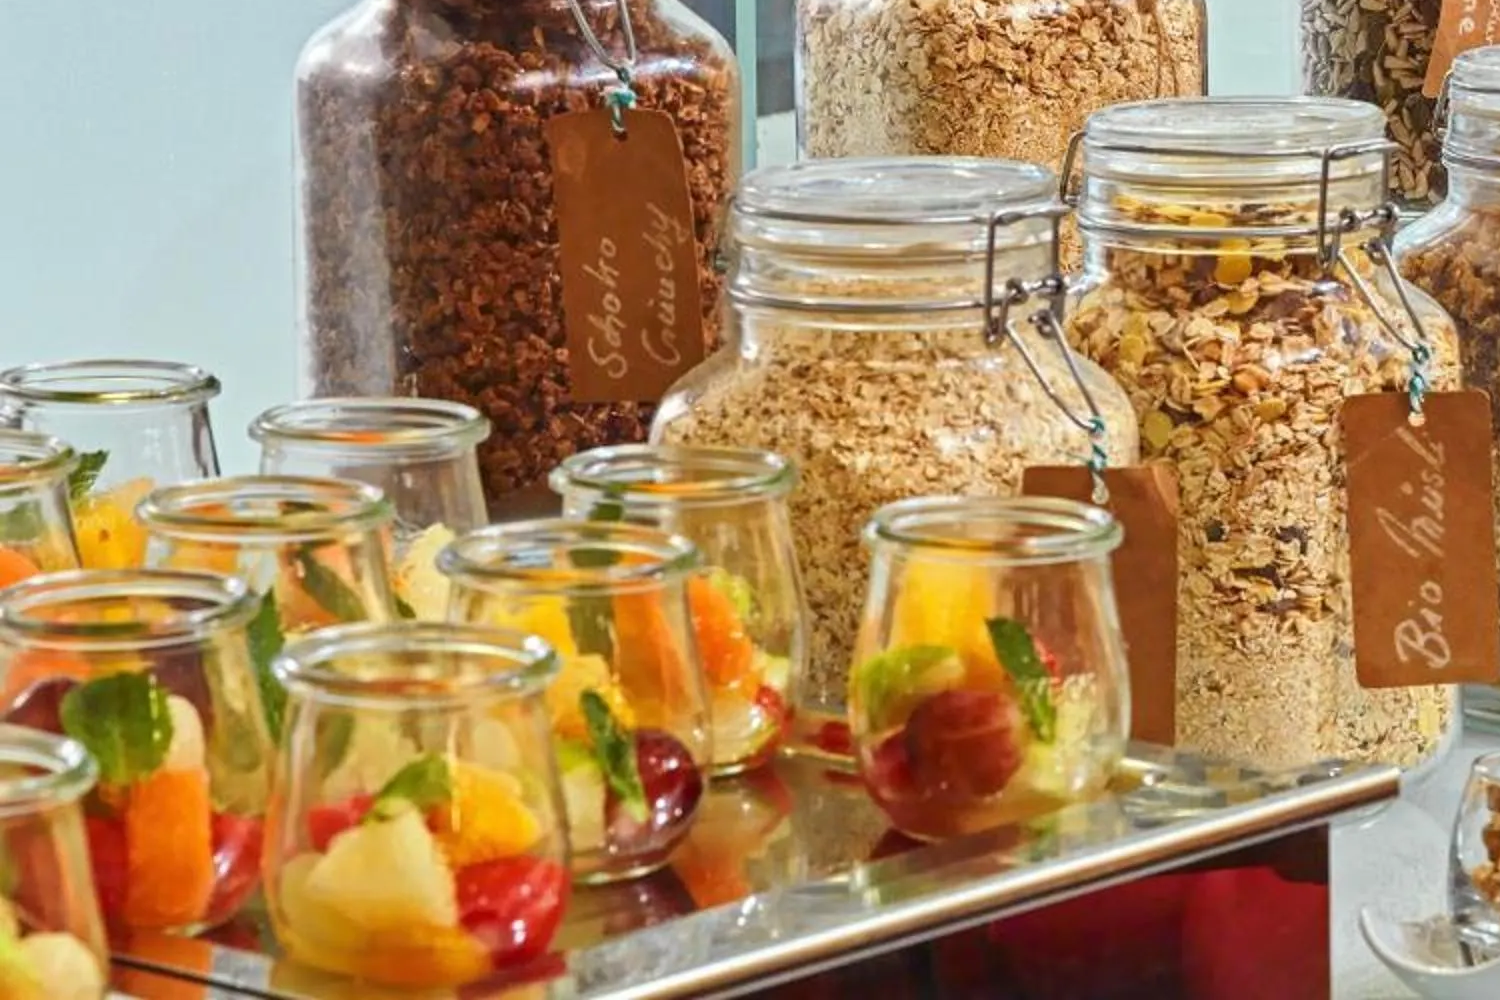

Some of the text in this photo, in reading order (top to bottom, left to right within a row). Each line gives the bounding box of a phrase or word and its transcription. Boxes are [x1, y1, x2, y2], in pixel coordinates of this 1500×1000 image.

[581, 236, 629, 380] Schoko
[1375, 426, 1451, 670] Bio Müsli
